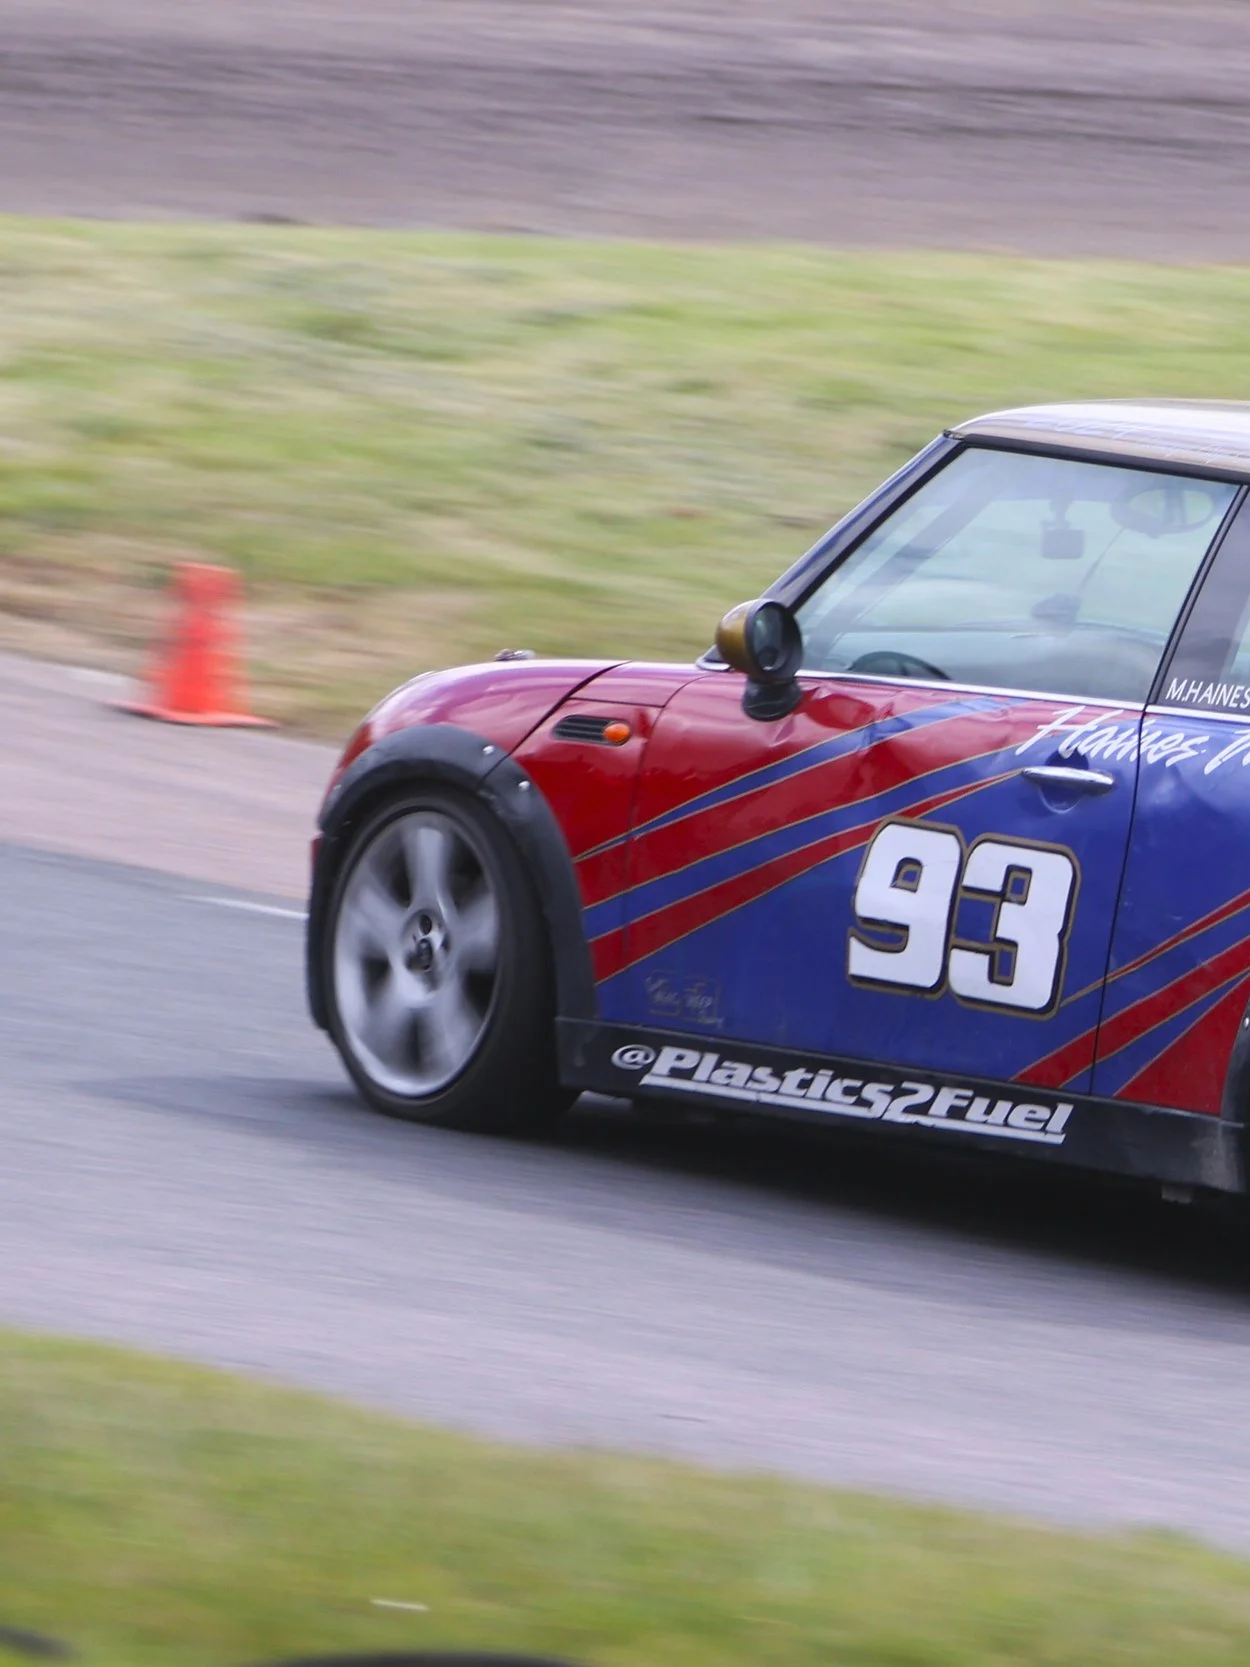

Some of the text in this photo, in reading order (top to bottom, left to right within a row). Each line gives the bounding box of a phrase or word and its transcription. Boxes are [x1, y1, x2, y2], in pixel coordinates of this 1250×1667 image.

[1016, 707, 1211, 768] Haines
[847, 818, 1078, 1016] 93
[611, 1043, 1074, 1135] @Plastics2Fuel
